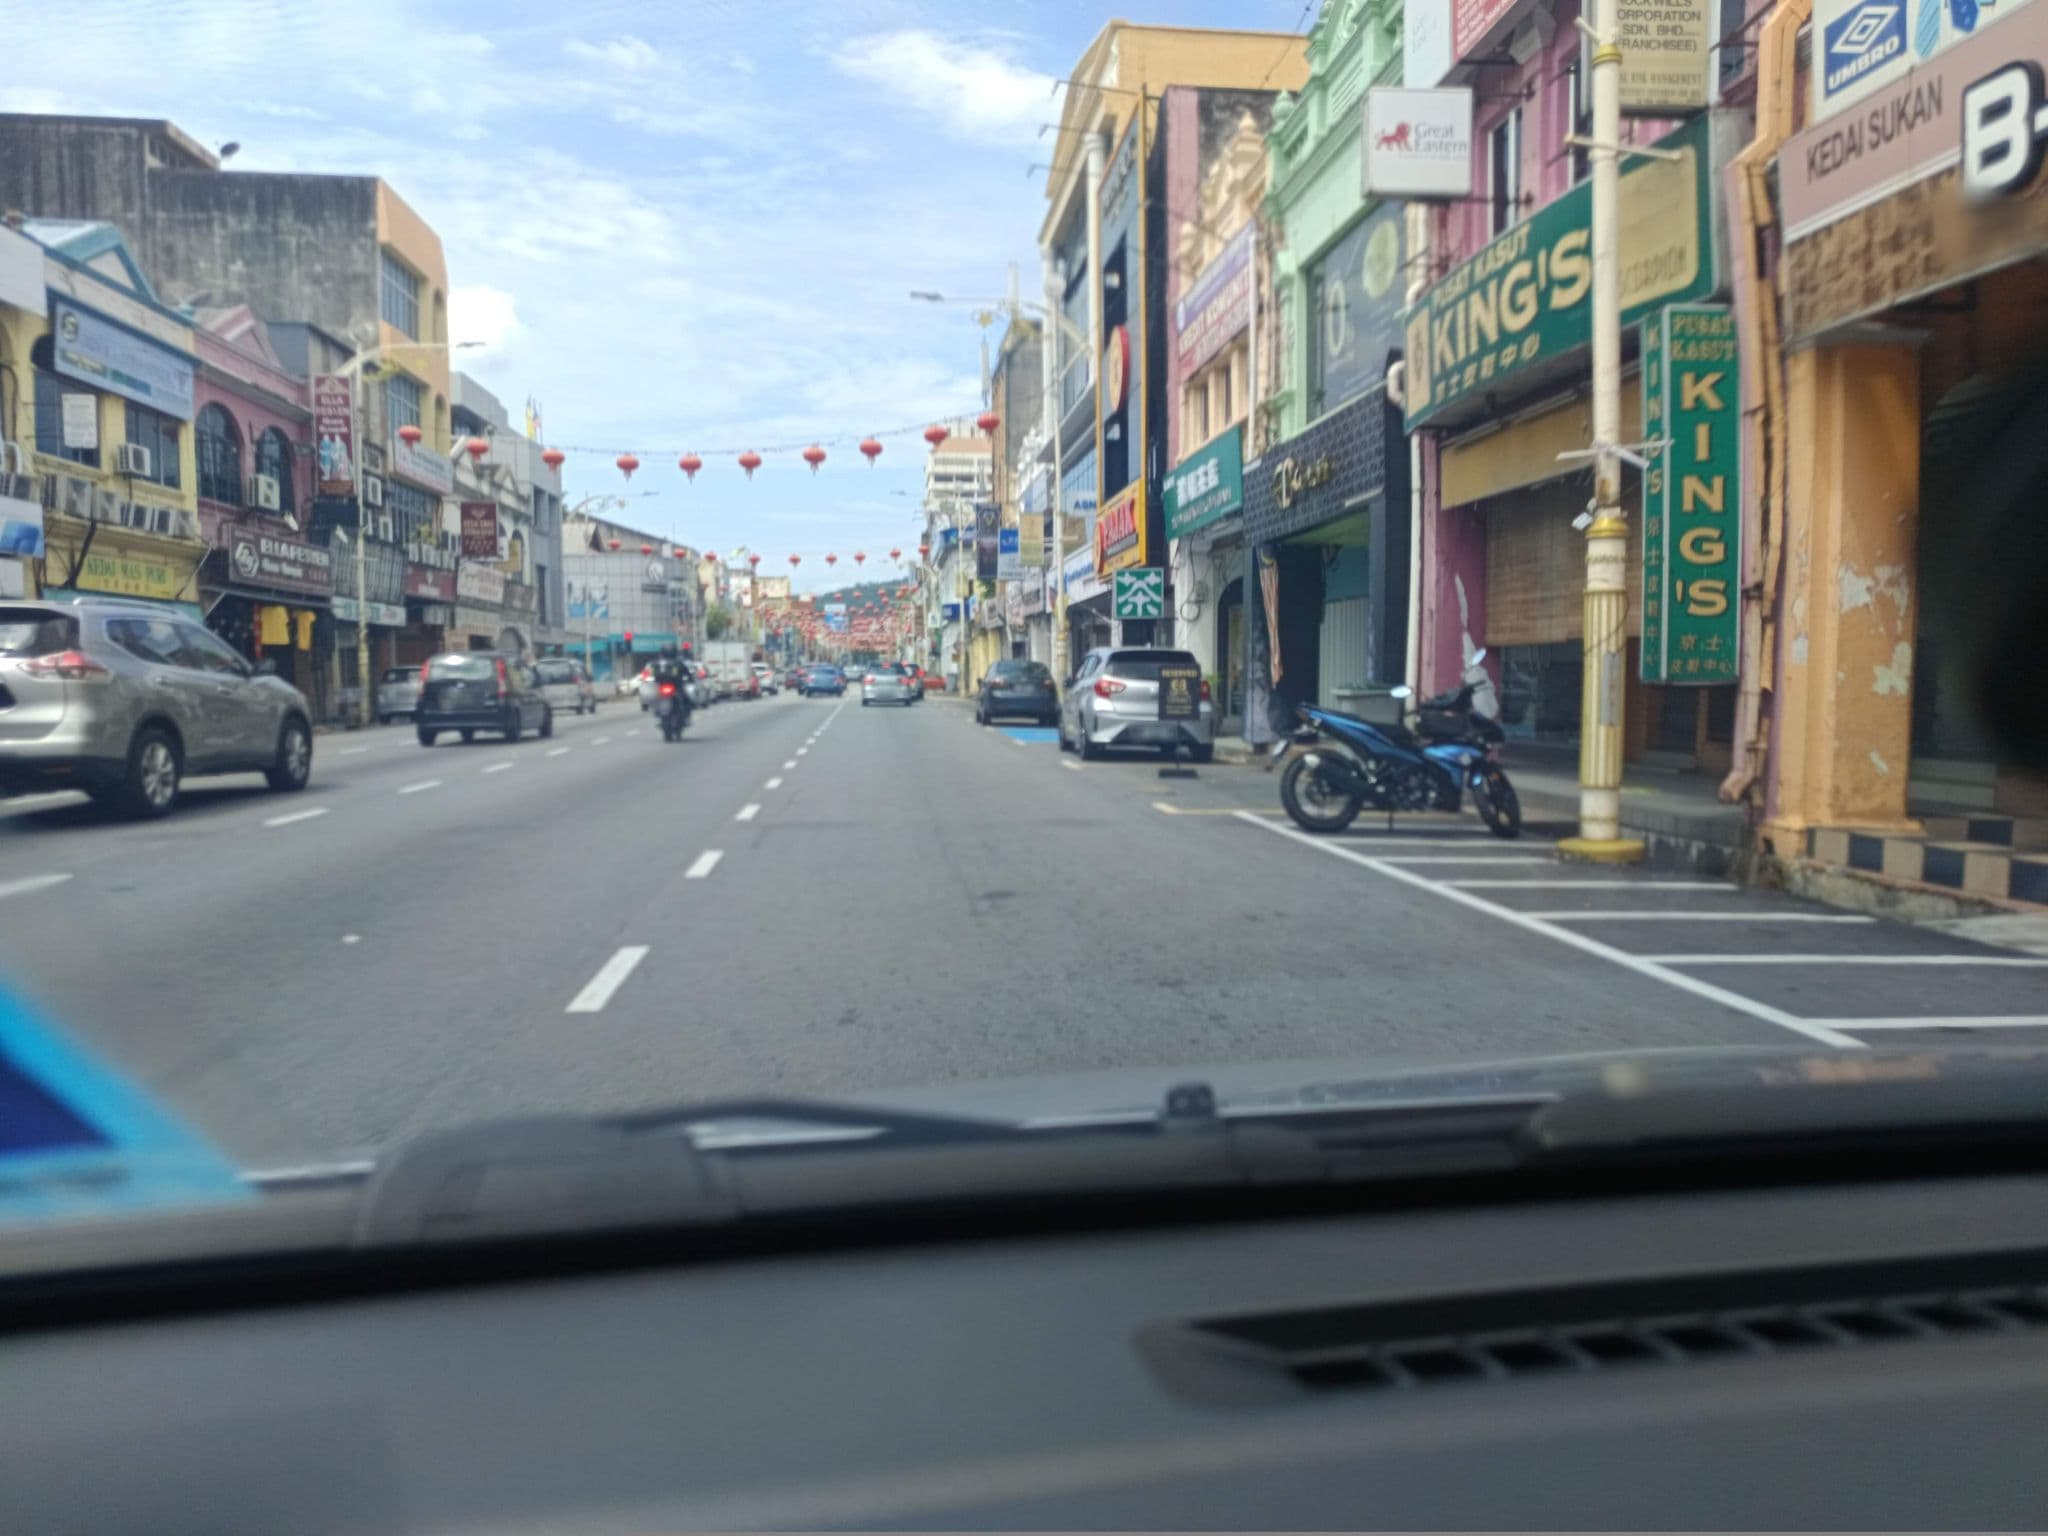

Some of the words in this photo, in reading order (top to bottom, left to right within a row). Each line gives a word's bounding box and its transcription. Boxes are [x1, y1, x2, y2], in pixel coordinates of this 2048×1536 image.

[1617, 9, 1701, 21] ORPORATION
[1617, 38, 1697, 53] RANCHISEE)
[1828, 35, 1901, 91] UMBRO
[1414, 122, 1455, 138] Great
[1806, 119, 1864, 184] KEDAI
[1867, 74, 1943, 151] SUKAN
[1414, 138, 1468, 153] Eastern
[1473, 223, 1531, 282] KASUT
[1433, 229, 1592, 376] KING'S
[1672, 315, 1731, 334] PUSAT
[1671, 340, 1735, 360] KASUT
[1676, 371, 1729, 617] KING'S
